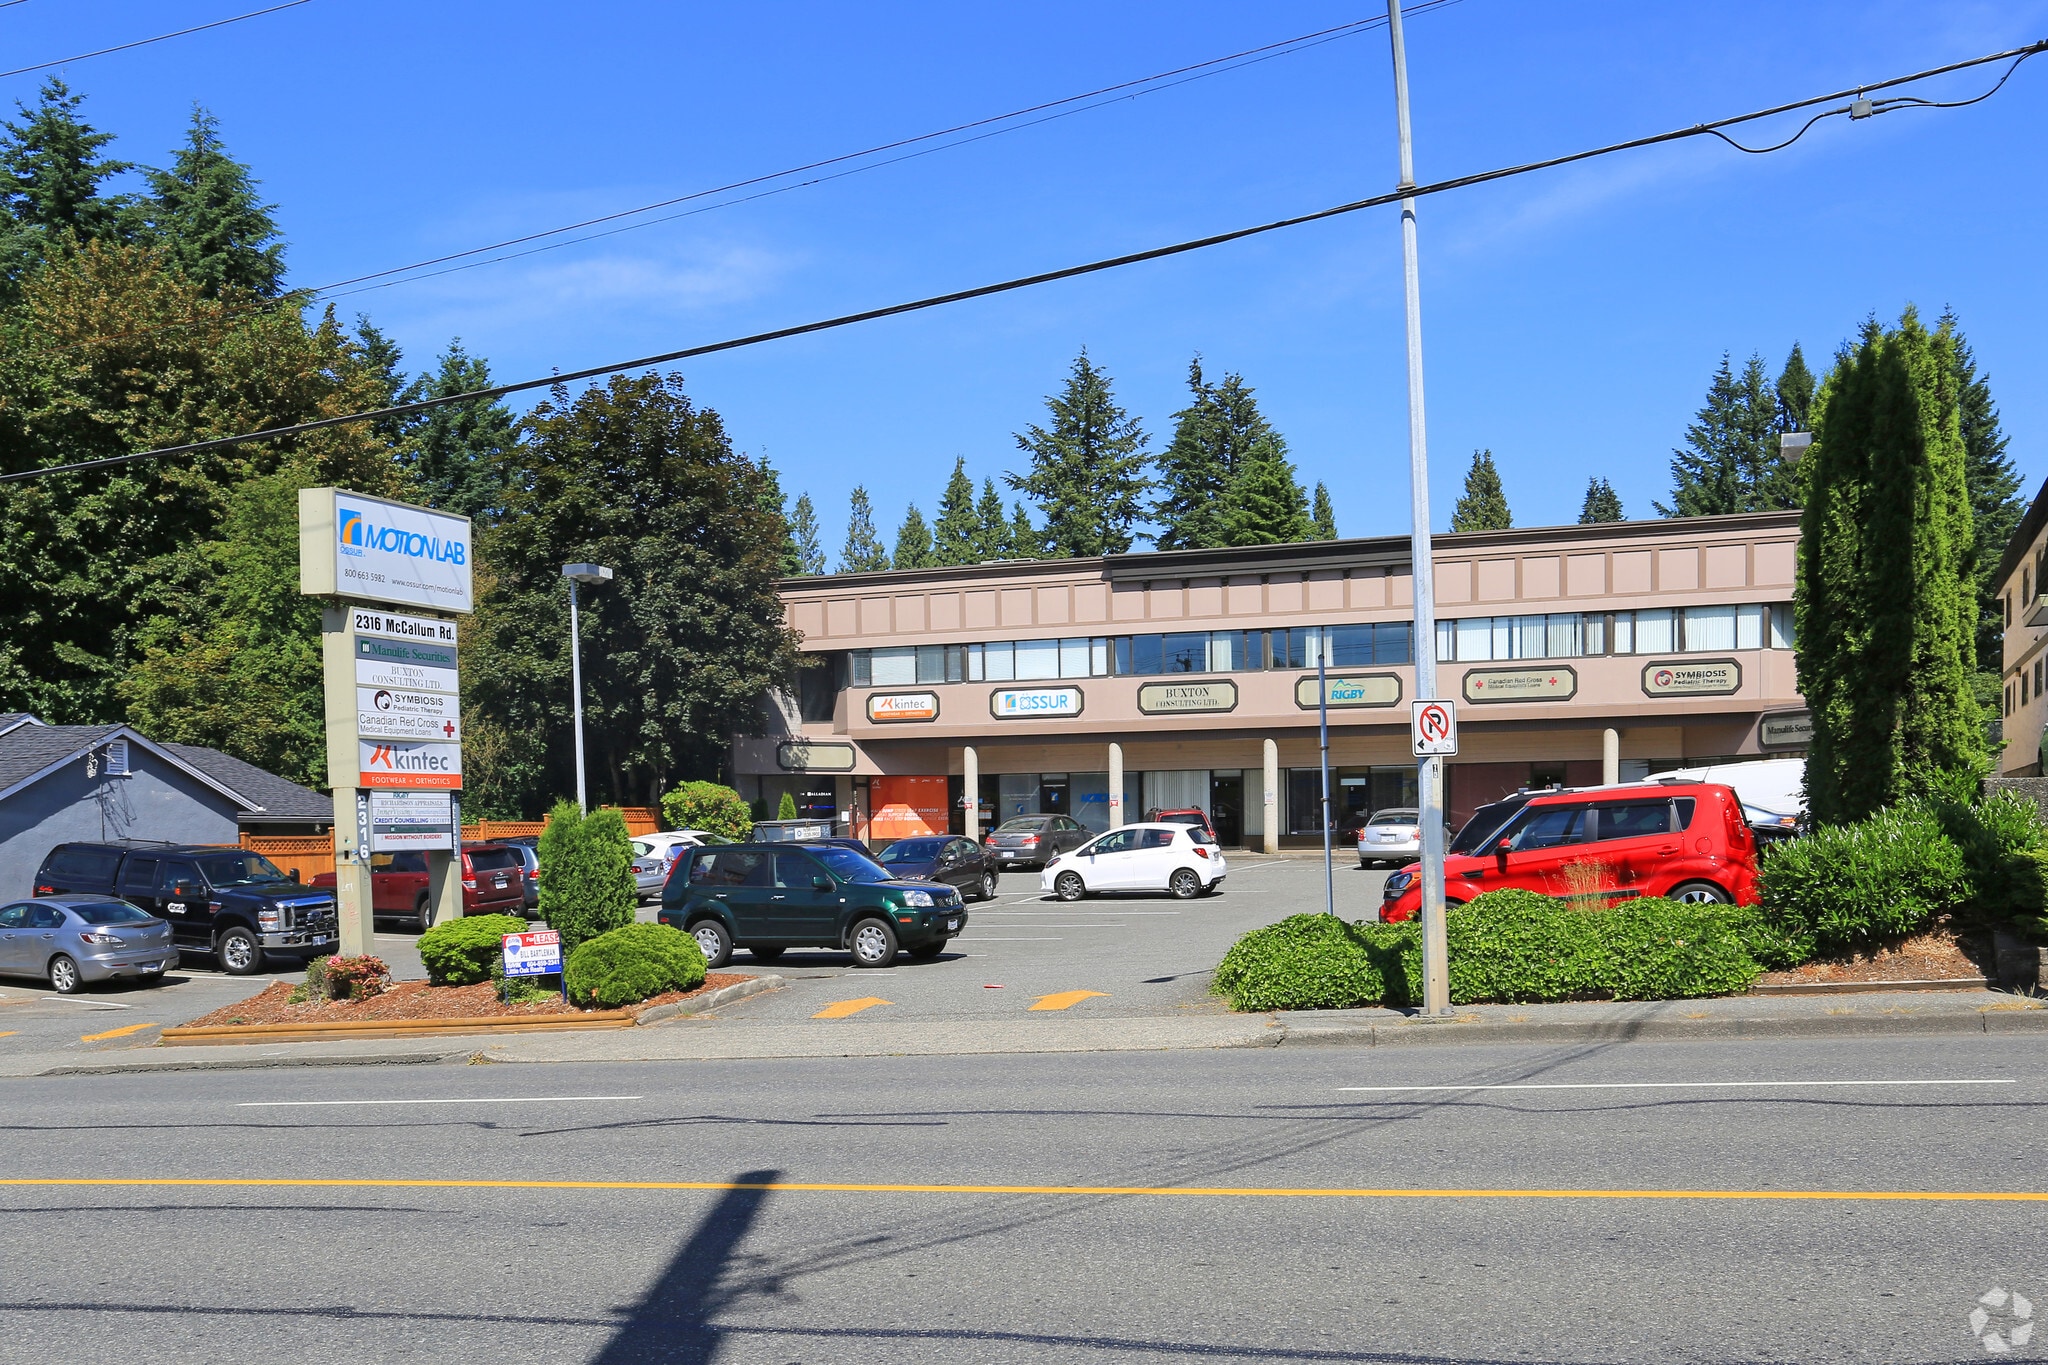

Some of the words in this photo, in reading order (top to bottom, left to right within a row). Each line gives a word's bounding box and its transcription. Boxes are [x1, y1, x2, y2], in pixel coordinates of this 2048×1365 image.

[344, 568, 356, 578] 800
[358, 570, 369, 580] 663
[370, 572, 386, 583] 5982
[391, 578, 464, 596] www.ossur.com/motionlab
[356, 614, 381, 630] 2316
[386, 618, 435, 638] McCallum
[440, 626, 455, 640] Rd.
[372, 644, 410, 658] Manulife
[412, 648, 450, 663] Securities
[391, 666, 424, 677] BUXTON
[1676, 670, 1726, 680] SYMBIOSIS
[372, 675, 424, 688] CONSULTING
[425, 680, 442, 690] LTD.
[1166, 688, 1210, 698] BUXTON
[1331, 689, 1365, 700] RIGBY
[394, 694, 444, 706] SYMBIOSIS
[894, 698, 925, 709] kintec
[393, 704, 419, 712] Pediatric
[420, 707, 442, 715] Therapy
[360, 714, 398, 726] Canadian
[400, 716, 416, 727] Red
[417, 718, 438, 728] Cross
[360, 725, 382, 734] Medical
[384, 726, 414, 736] Equipment
[1768, 725, 1794, 734] Manulife
[394, 746, 448, 770] kintec
[534, 933, 559, 944] LEASE
[520, 950, 530, 958] BILL
[530, 948, 556, 958] BARTLEMAN
